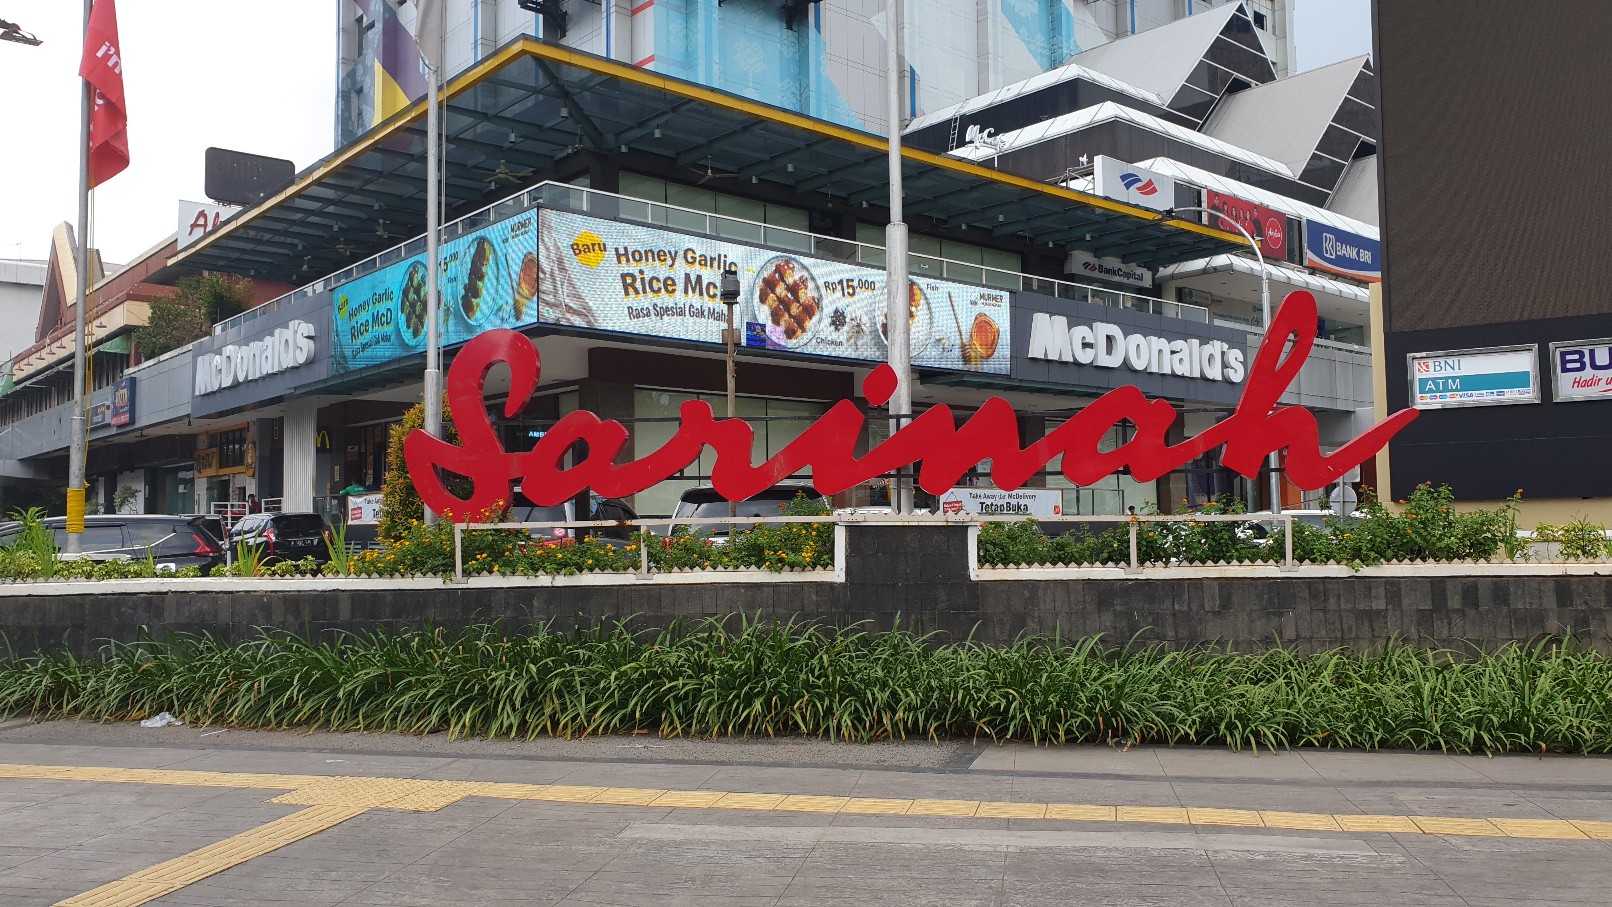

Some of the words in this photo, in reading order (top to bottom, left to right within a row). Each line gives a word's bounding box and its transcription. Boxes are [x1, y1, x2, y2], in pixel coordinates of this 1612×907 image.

[570, 243, 607, 256] Baru
[614, 246, 679, 268] Honey
[1336, 241, 1359, 261] BANK
[1360, 248, 1372, 264] BRI
[1098, 264, 1144, 281] BankCapital
[621, 269, 677, 297] Rice
[684, 273, 720, 300] Mc
[926, 284, 939, 292] Fish
[349, 297, 371, 322] Honey
[372, 287, 394, 306] Garlic
[627, 306, 651, 320] Rasa
[653, 302, 686, 321] Spesial
[689, 304, 706, 319] Gak
[708, 307, 728, 323] Mah
[350, 319, 370, 343] Rice
[372, 308, 393, 330] McD
[1028, 312, 1245, 383] McDonald's
[195, 319, 315, 396] McDonald's
[1433, 359, 1462, 373] BNI
[1425, 378, 1461, 392] ATM
[1571, 374, 1603, 389] Hadir
[1459, 391, 1474, 399] VISA
[404, 290, 1419, 521] Sarinah
[528, 430, 547, 438] AMB
[969, 492, 982, 500] Take
[983, 492, 997, 501] Away
[1008, 492, 1037, 502] McDelivery
[979, 501, 1005, 513] Tetap
[1005, 501, 1029, 513] Buka
